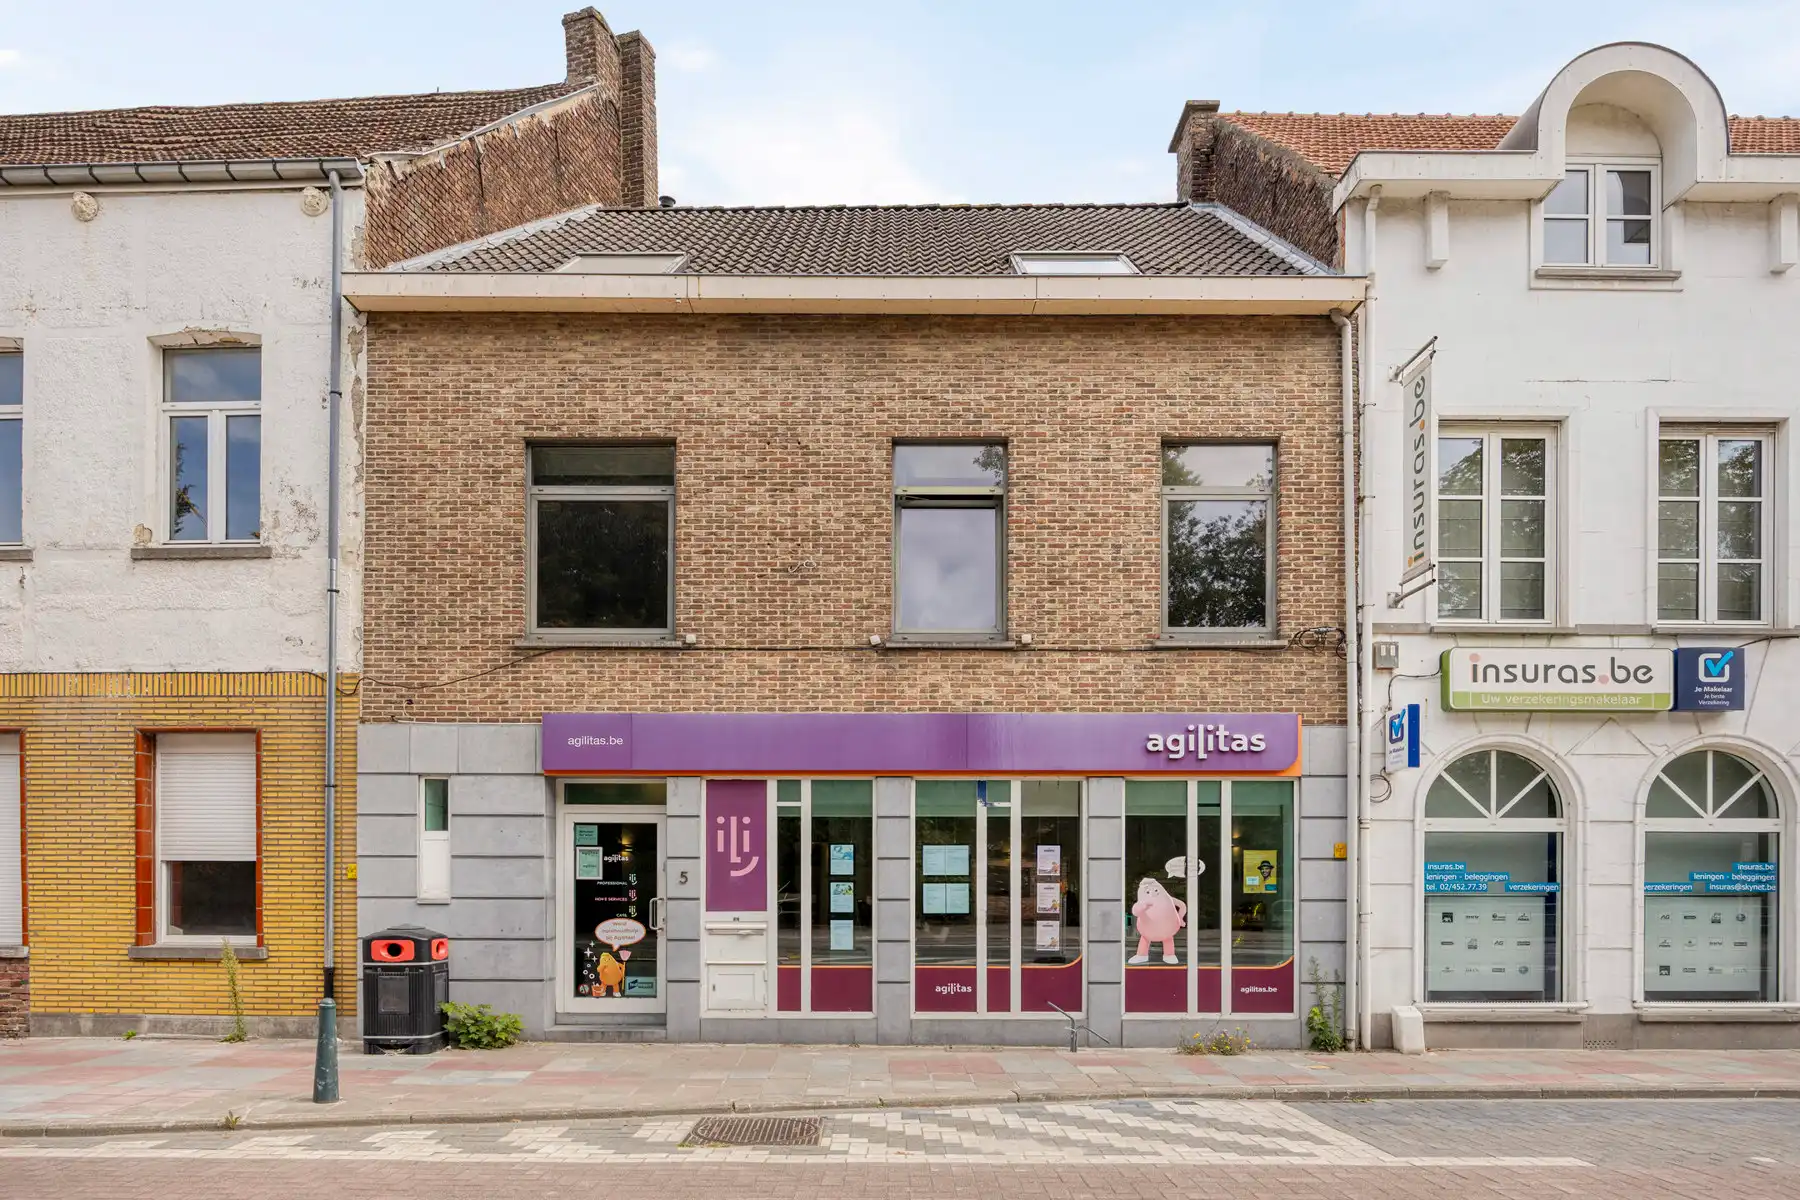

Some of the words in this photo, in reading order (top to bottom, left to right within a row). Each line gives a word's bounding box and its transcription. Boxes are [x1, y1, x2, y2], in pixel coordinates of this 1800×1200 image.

[1407, 375, 1425, 568] insuras.be
[1469, 653, 1654, 684] insuras.be
[1481, 694, 1500, 704] Uw
[1505, 694, 1642, 707] verzekeringsmakelaar
[567, 736, 624, 748] agilitas.be
[1146, 724, 1266, 759] agilitas
[603, 854, 629, 862] agilitas
[679, 871, 689, 885] 5
[1464, 872, 1508, 882] beleggingen
[1693, 873, 1725, 881] leningen
[1731, 873, 1775, 882] beleggingen
[1439, 883, 1488, 891] 02/452.77.39
[1509, 884, 1559, 892] verzekeringen
[1709, 883, 1776, 892] insuras@skynet.be
[935, 983, 972, 995] agilitas
[1240, 985, 1278, 994] agilitas.be
